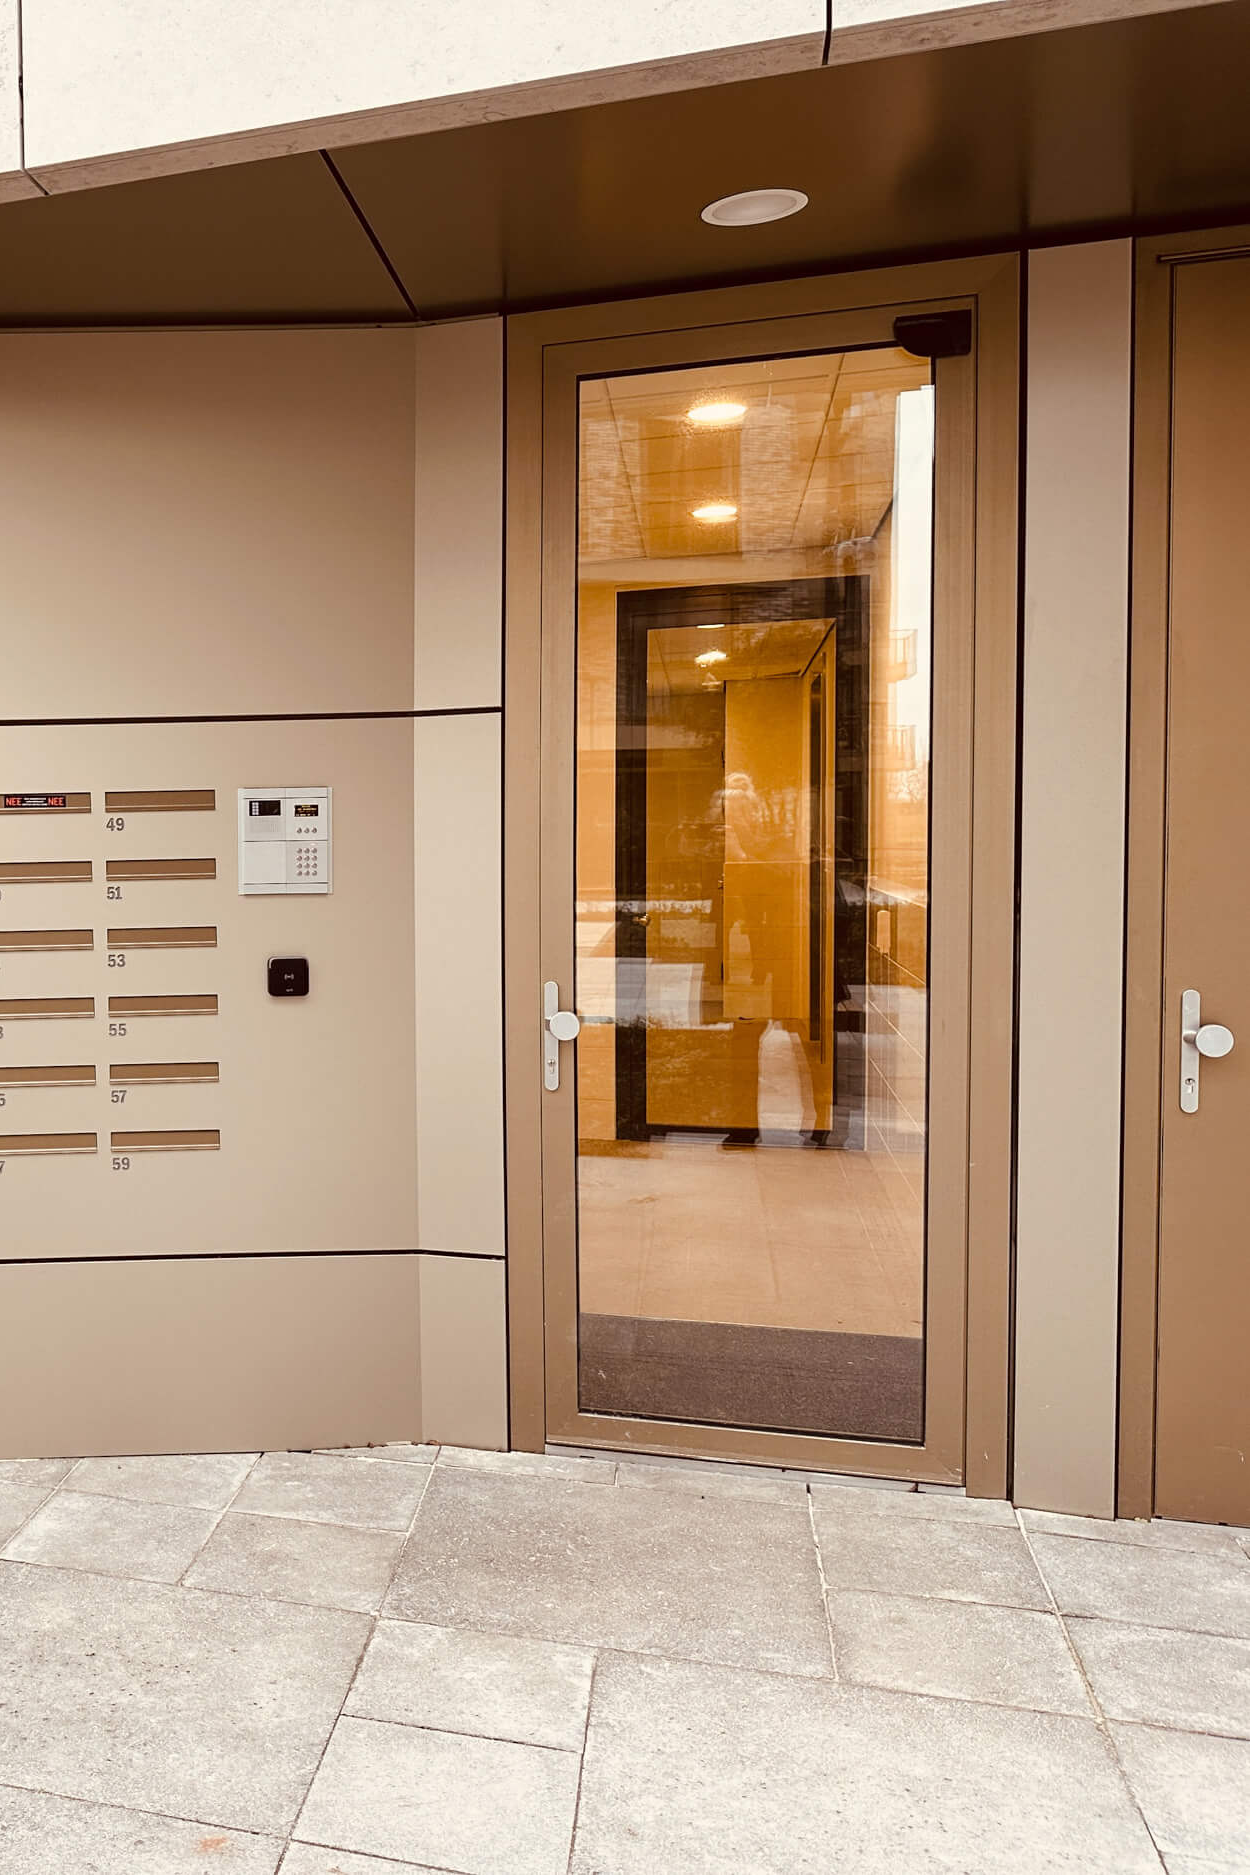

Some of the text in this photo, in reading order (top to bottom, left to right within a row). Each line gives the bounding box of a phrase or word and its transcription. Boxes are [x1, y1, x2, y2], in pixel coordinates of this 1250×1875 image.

[5, 797, 22, 806] NEE
[48, 797, 64, 806] NEE
[105, 817, 125, 832] 49
[106, 885, 123, 900] 51
[107, 953, 126, 968] 53
[108, 1023, 127, 1037] 55
[110, 1089, 128, 1104] 57
[112, 1156, 130, 1171] 59
